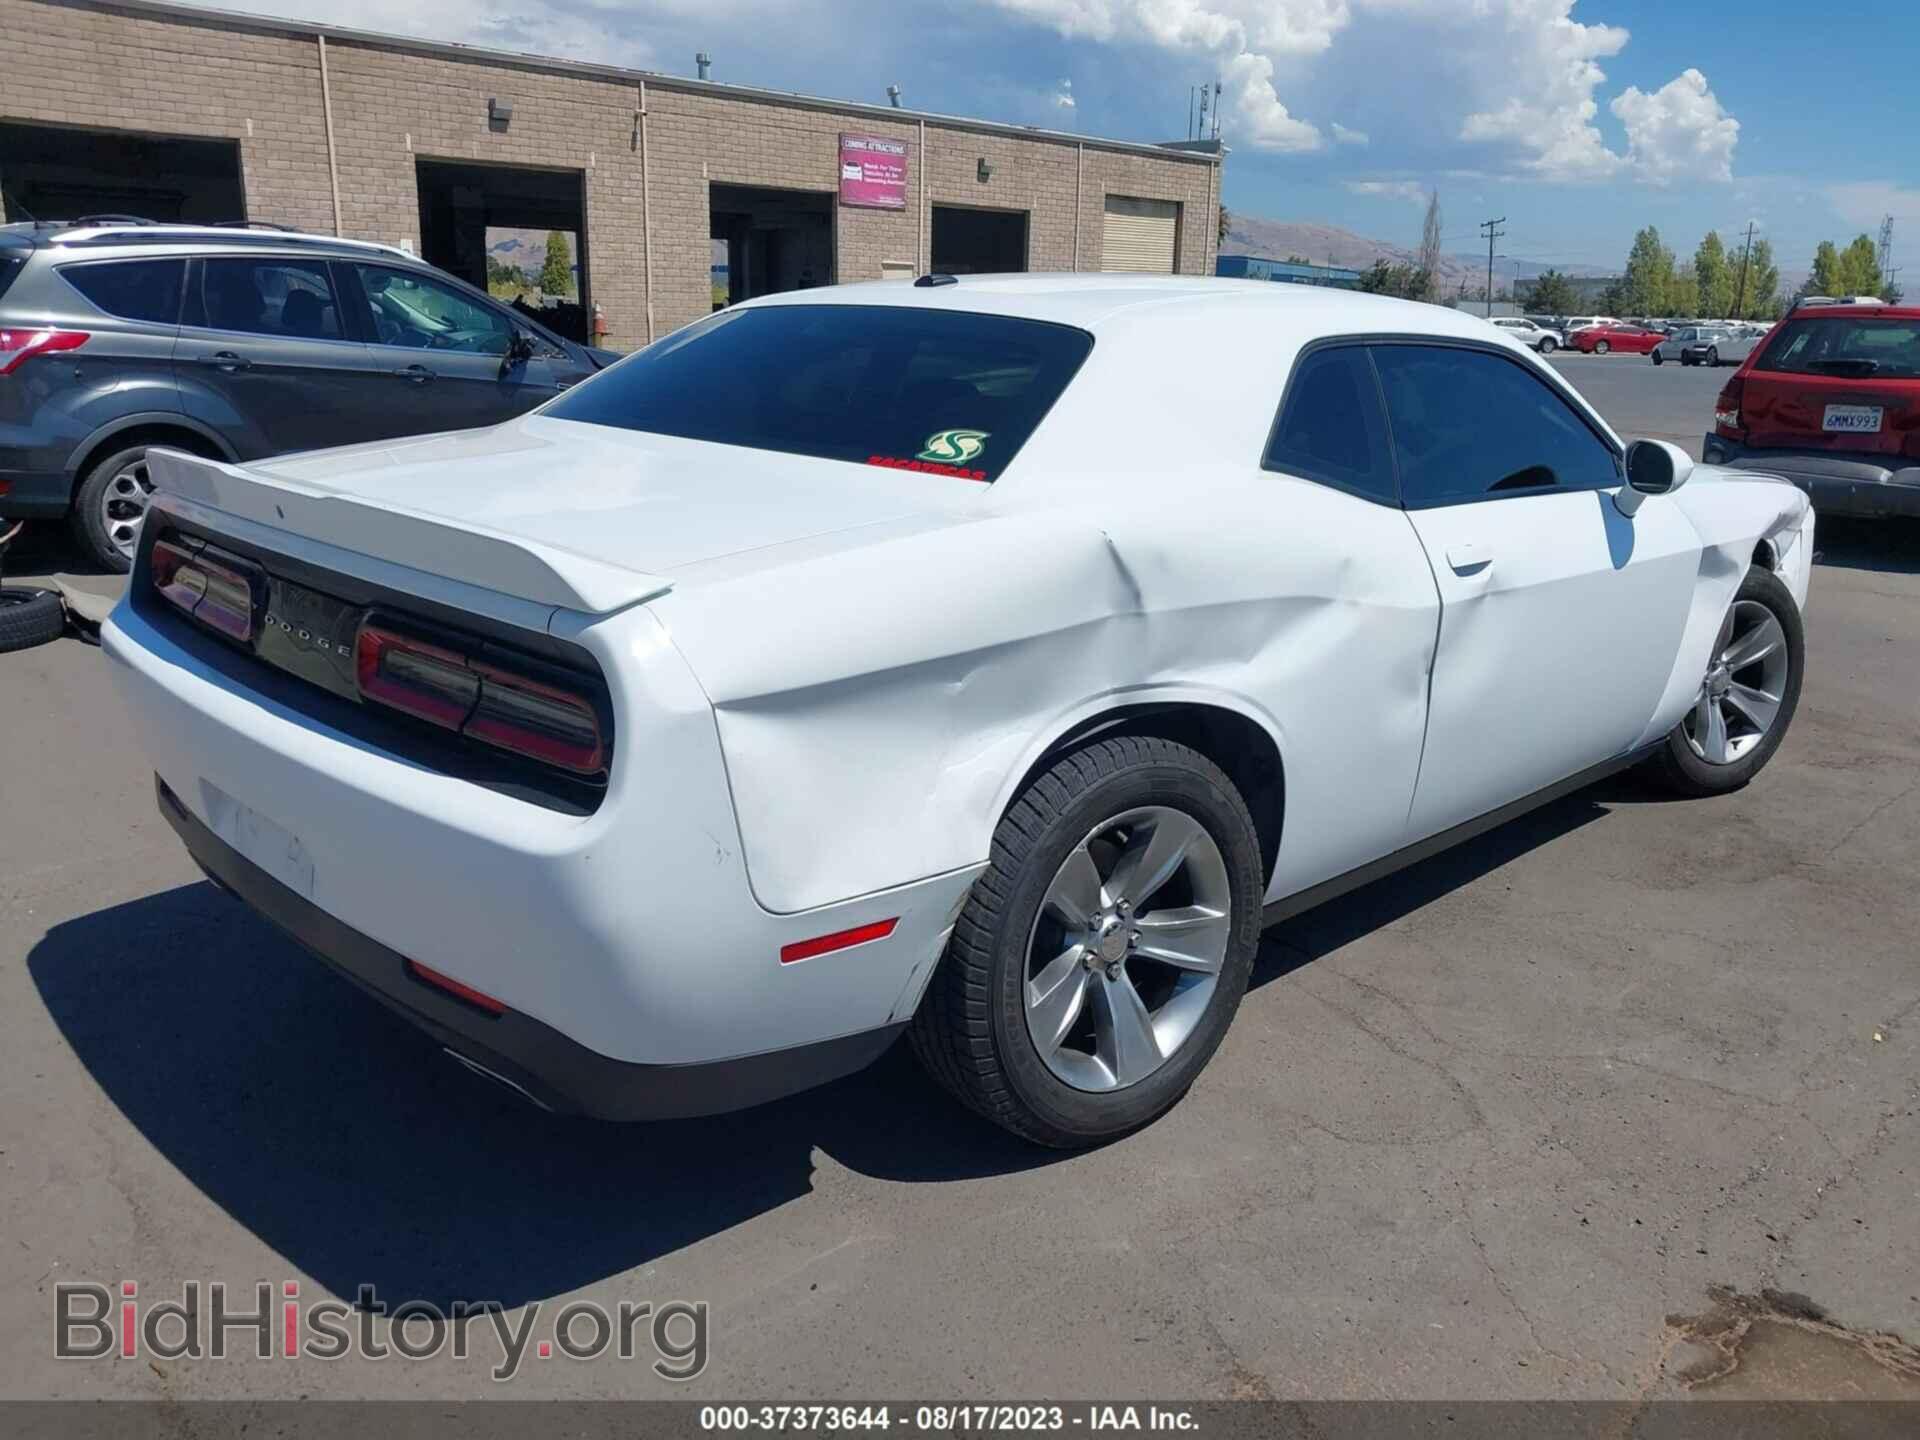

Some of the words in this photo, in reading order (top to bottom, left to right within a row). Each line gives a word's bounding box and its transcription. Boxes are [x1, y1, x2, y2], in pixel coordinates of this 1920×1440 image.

[844, 140, 867, 149] COMING
[867, 141, 905, 154] ATTRACTIONS
[1826, 414, 1878, 428] 6MMX993
[264, 613, 351, 657] DODGE
